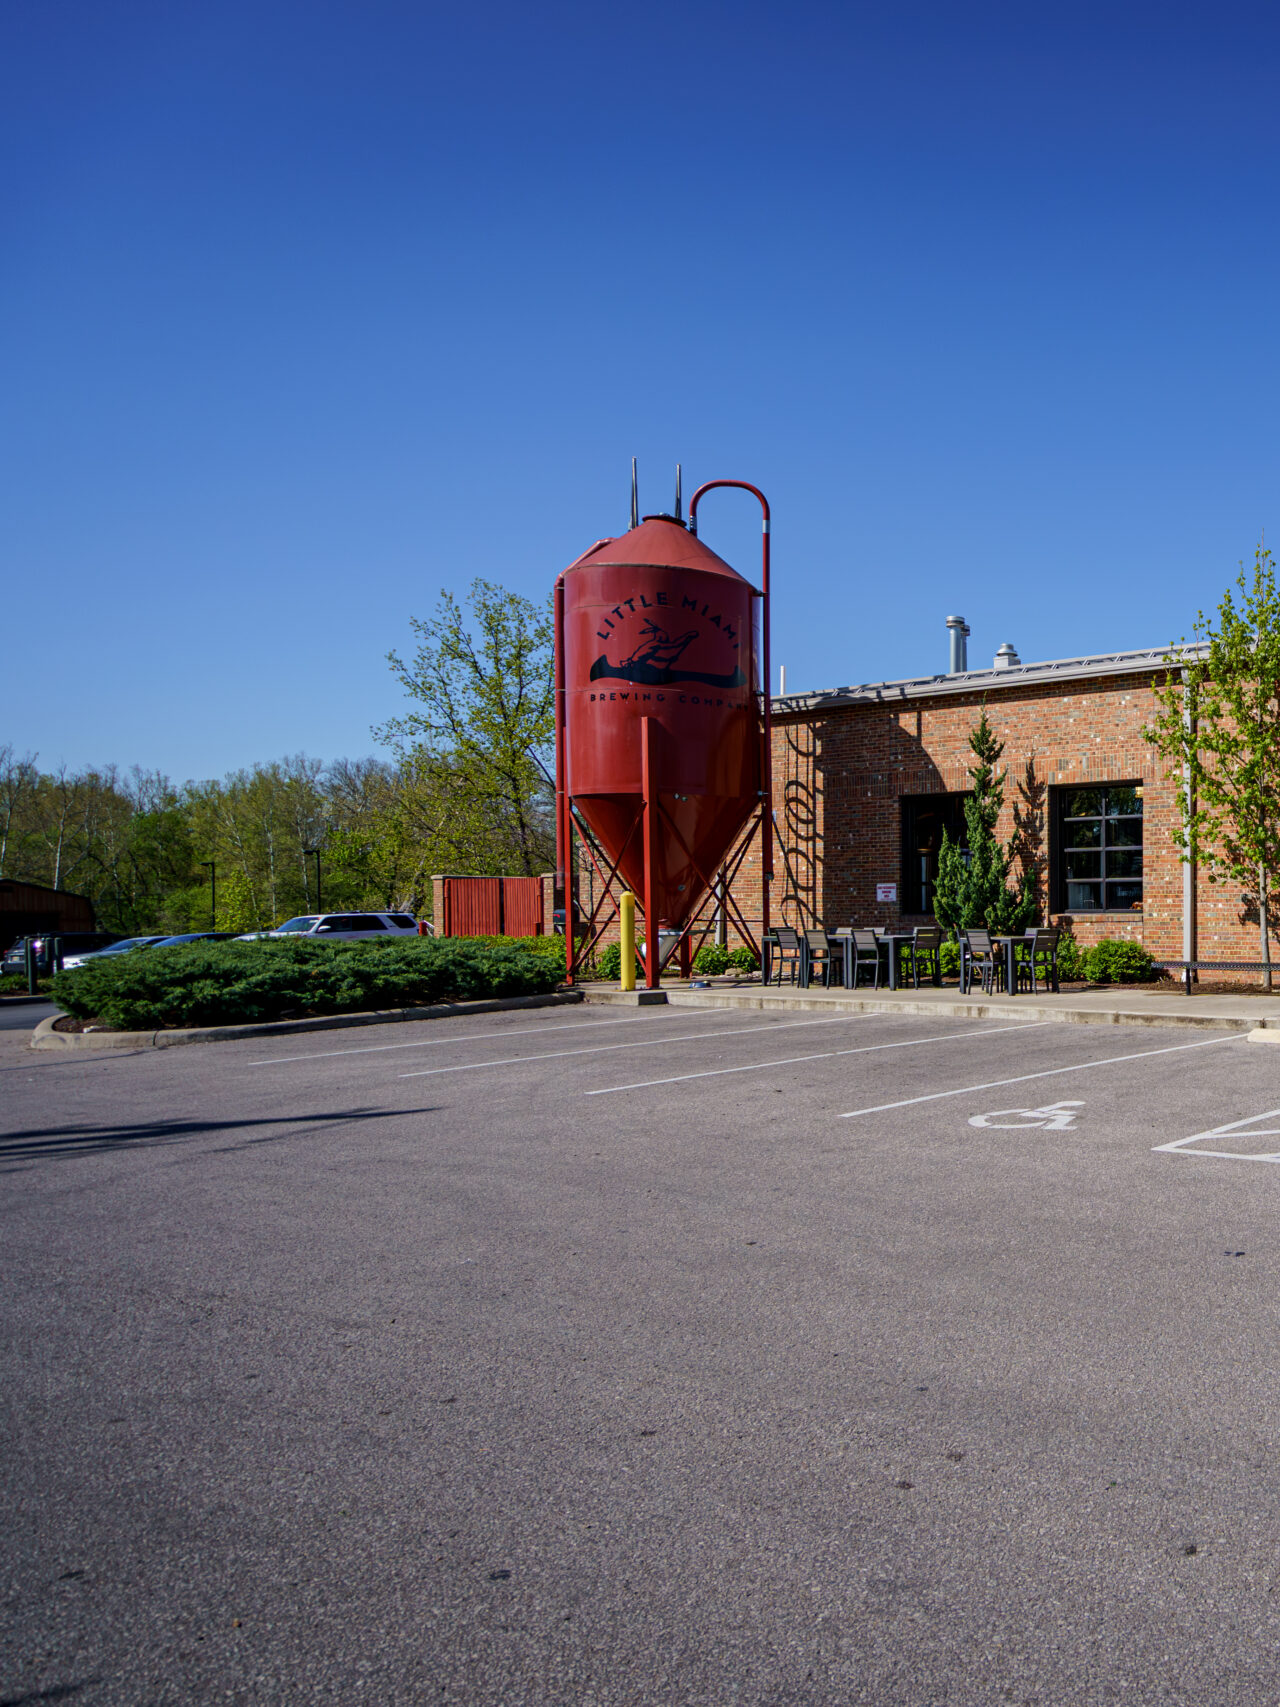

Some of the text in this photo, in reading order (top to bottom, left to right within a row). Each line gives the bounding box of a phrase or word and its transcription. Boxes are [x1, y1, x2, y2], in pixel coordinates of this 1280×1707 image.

[596, 591, 741, 649] LITTLE MIAMI
[590, 692, 748, 710] BREWING COMPANY
